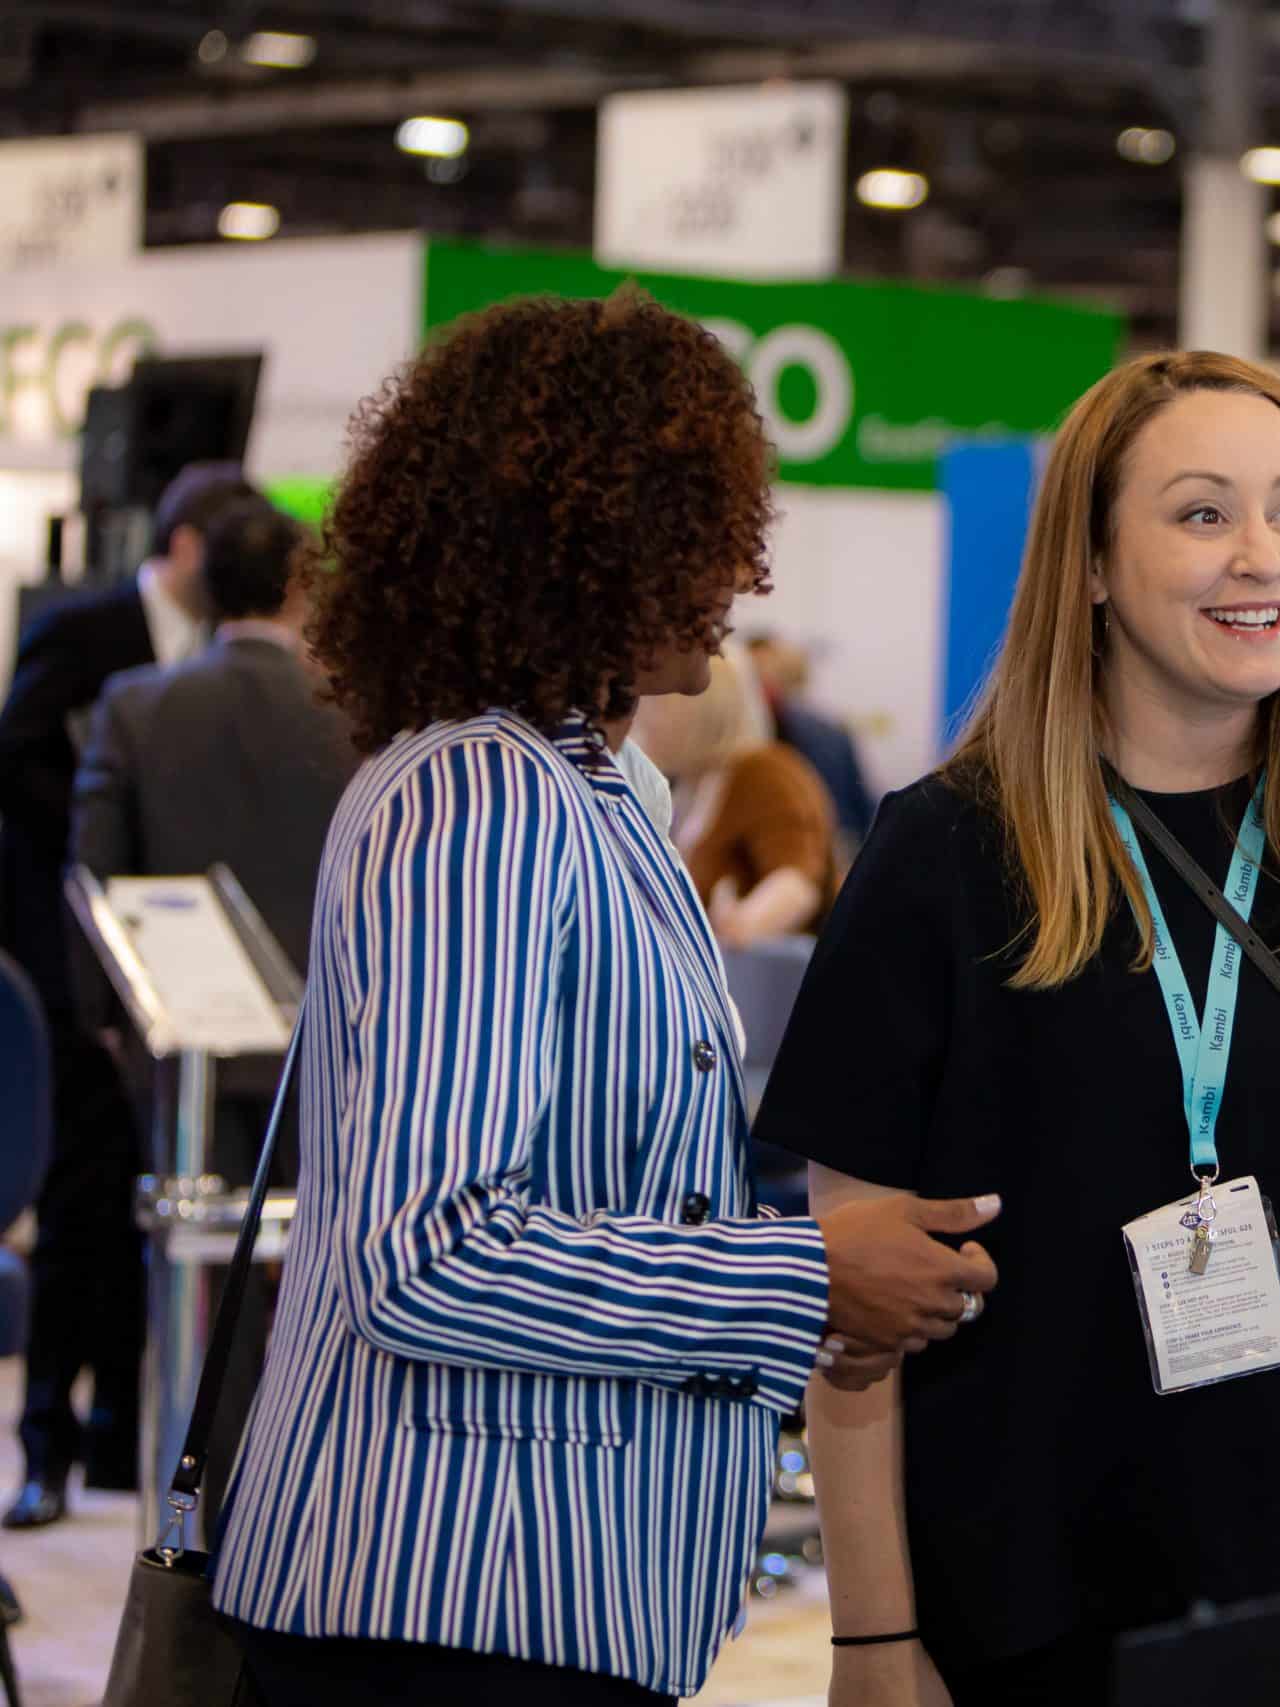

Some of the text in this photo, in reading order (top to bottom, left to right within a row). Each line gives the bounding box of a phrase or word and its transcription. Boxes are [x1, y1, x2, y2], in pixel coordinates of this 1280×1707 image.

[1172, 993, 1195, 1040] Kambi
[1209, 1007, 1227, 1051] Kambi
[1199, 1085, 1217, 1134] Kambi
